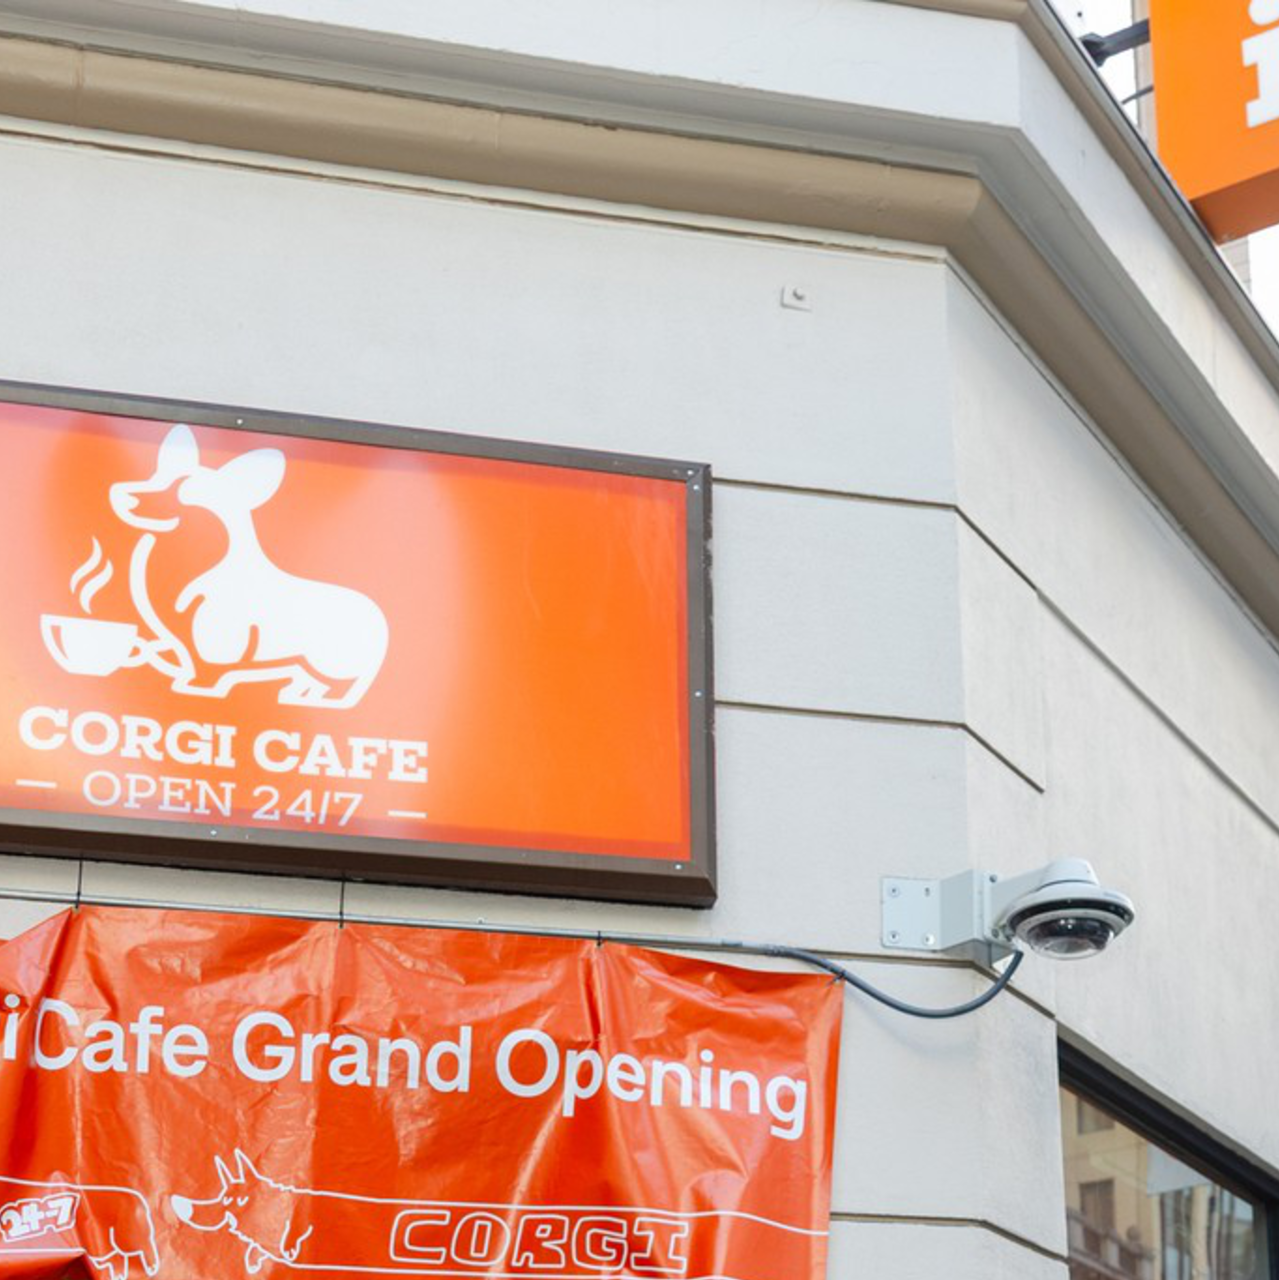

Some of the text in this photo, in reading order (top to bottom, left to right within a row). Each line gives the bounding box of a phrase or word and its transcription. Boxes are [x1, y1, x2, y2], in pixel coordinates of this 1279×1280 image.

[19, 706, 429, 783] CORGI CAFE
[82, 770, 363, 826] OPEN 24/7
[32, 997, 210, 1078] Cafe
[232, 1011, 472, 1093] Grand
[495, 1029, 808, 1140] Opening
[389, 1209, 689, 1274] CORGI
